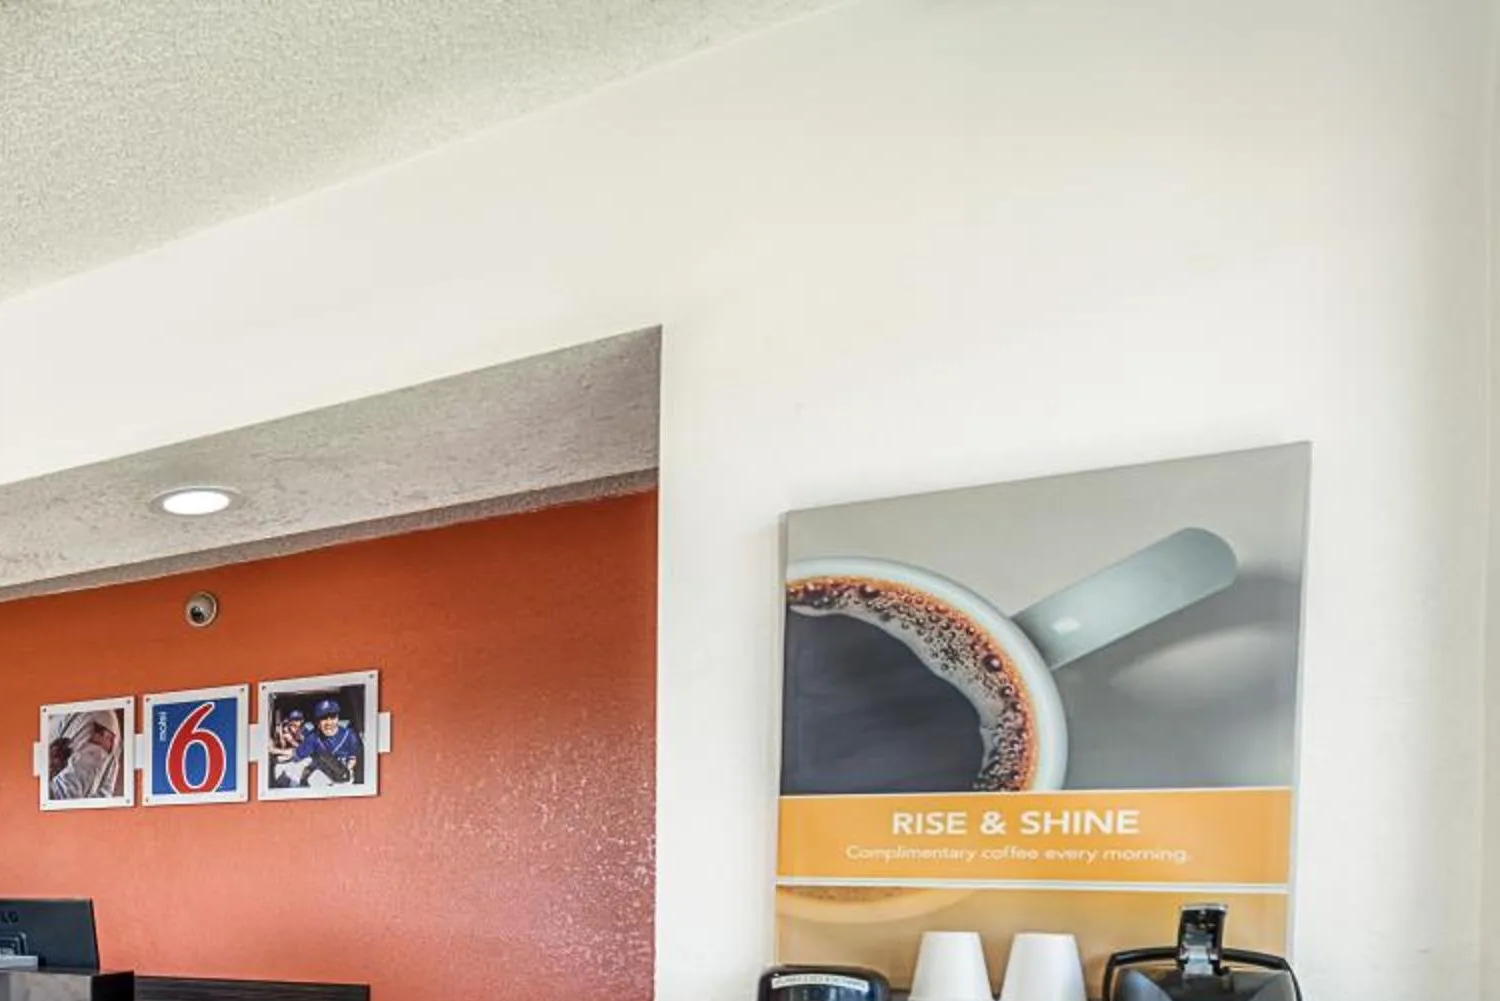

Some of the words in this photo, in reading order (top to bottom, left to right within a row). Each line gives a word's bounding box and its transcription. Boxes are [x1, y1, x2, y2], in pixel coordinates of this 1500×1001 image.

[165, 701, 227, 796] 6
[891, 811, 967, 836] RISE
[979, 810, 1007, 836] &
[1019, 809, 1141, 836] SHINE
[845, 844, 976, 864] Complimentary
[980, 845, 1039, 861] coffee
[1045, 849, 1099, 865] every
